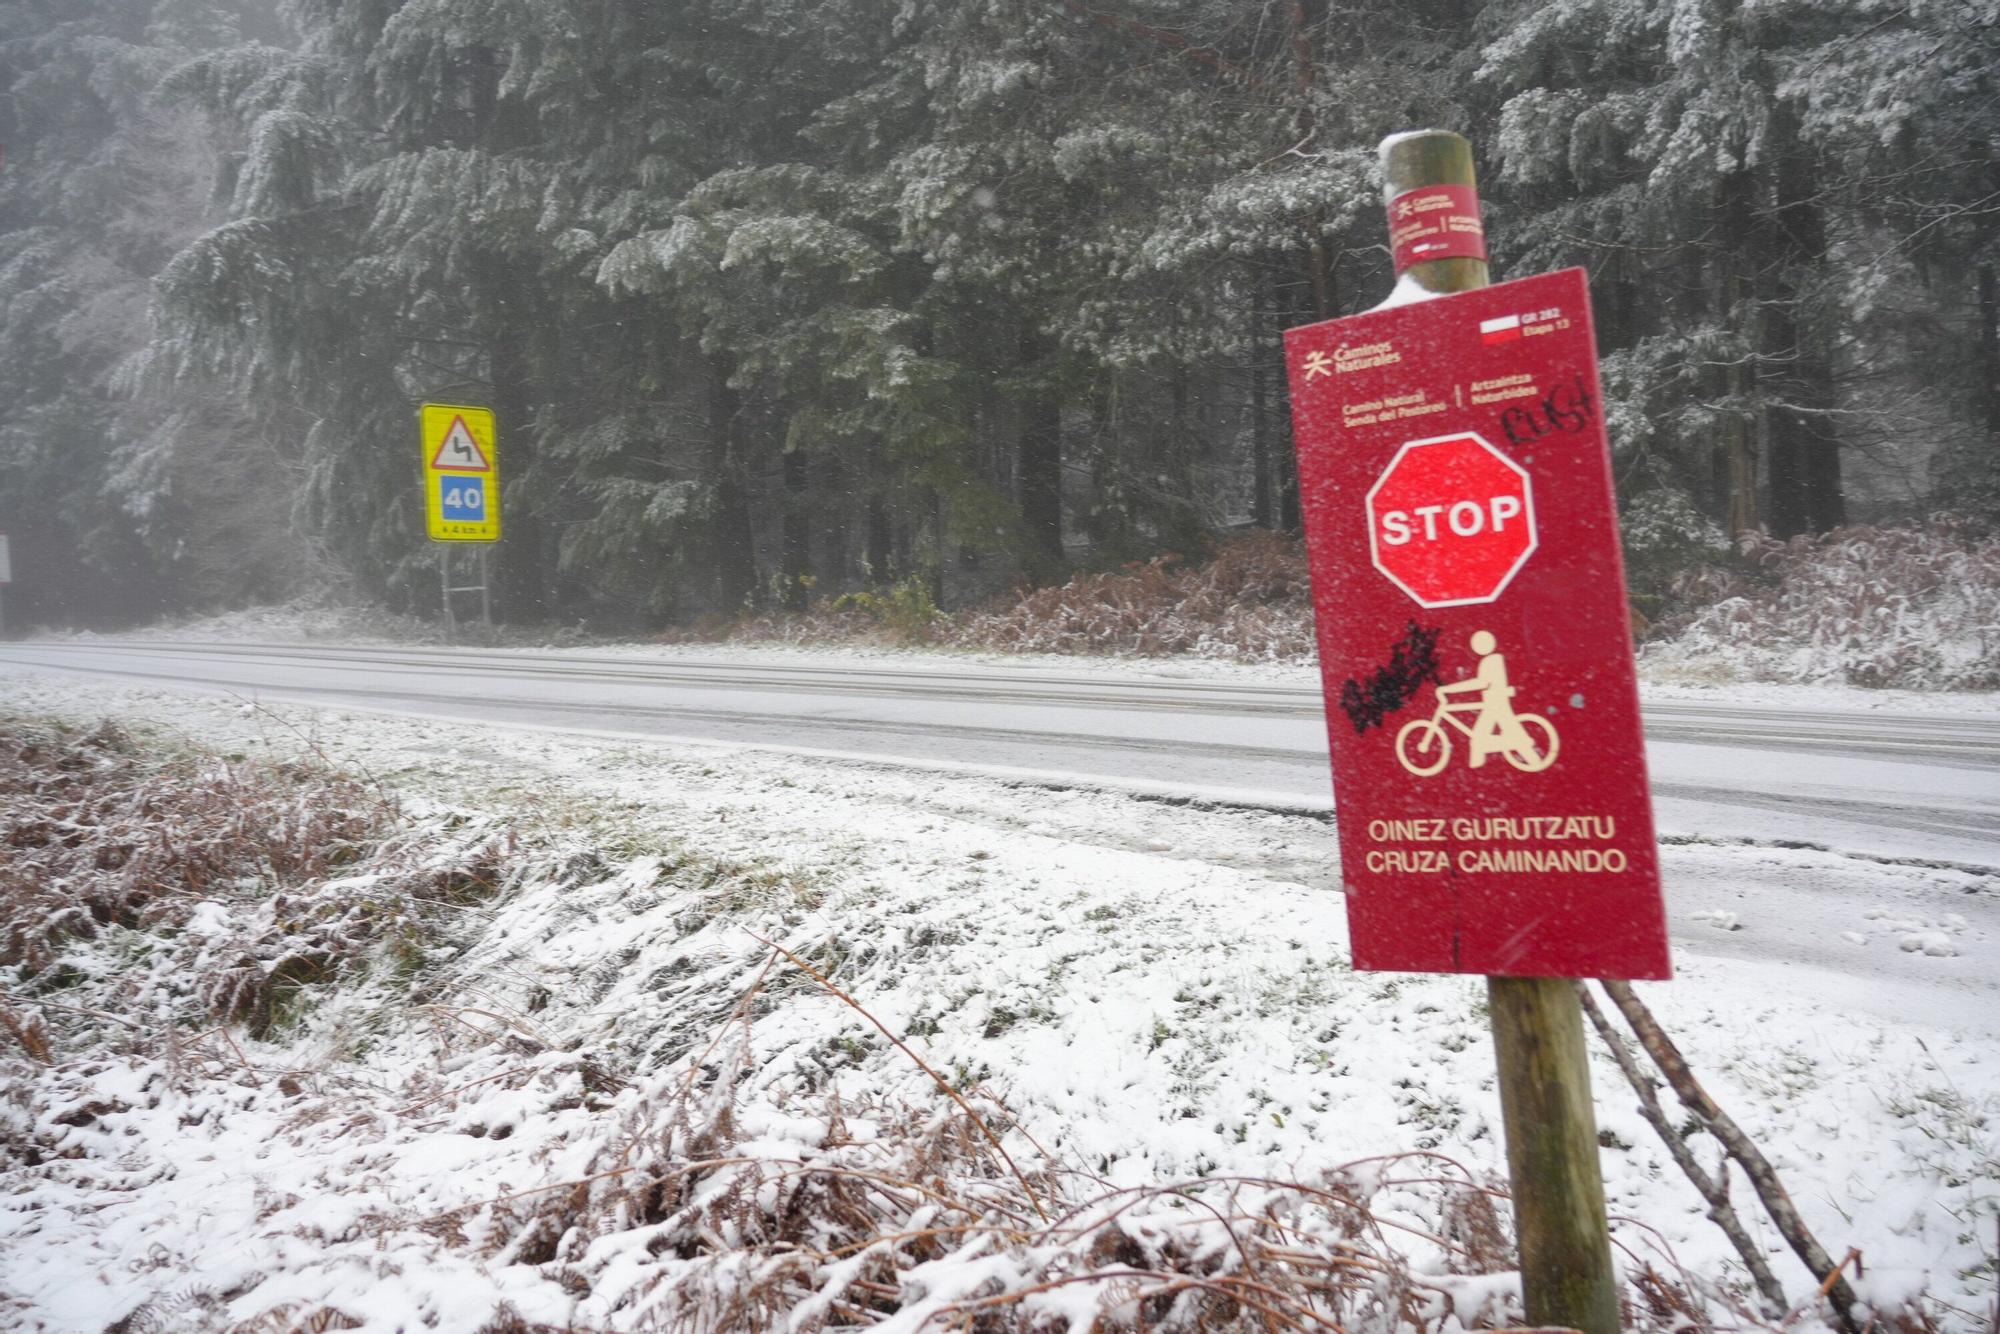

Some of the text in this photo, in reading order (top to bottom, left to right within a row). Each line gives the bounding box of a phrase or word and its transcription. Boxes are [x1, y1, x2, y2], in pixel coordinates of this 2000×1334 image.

[1521, 307, 1560, 324] GR 282
[1523, 318, 1571, 336] Etapa 13
[1334, 342, 1392, 361] Caminos
[1335, 352, 1401, 373] Naturales
[1470, 374, 1532, 392] Artzaintza
[1342, 389, 1425, 415] Camino Natural
[1471, 386, 1538, 405] Naturbidea
[1344, 402, 1447, 428] Senda del Pastoreo
[444, 487, 481, 509] 40
[1382, 495, 1521, 545] STOP
[1367, 815, 1616, 842] OINEZ GURUTZATU
[1366, 848, 1628, 873] CRUZA CAMINANDO
